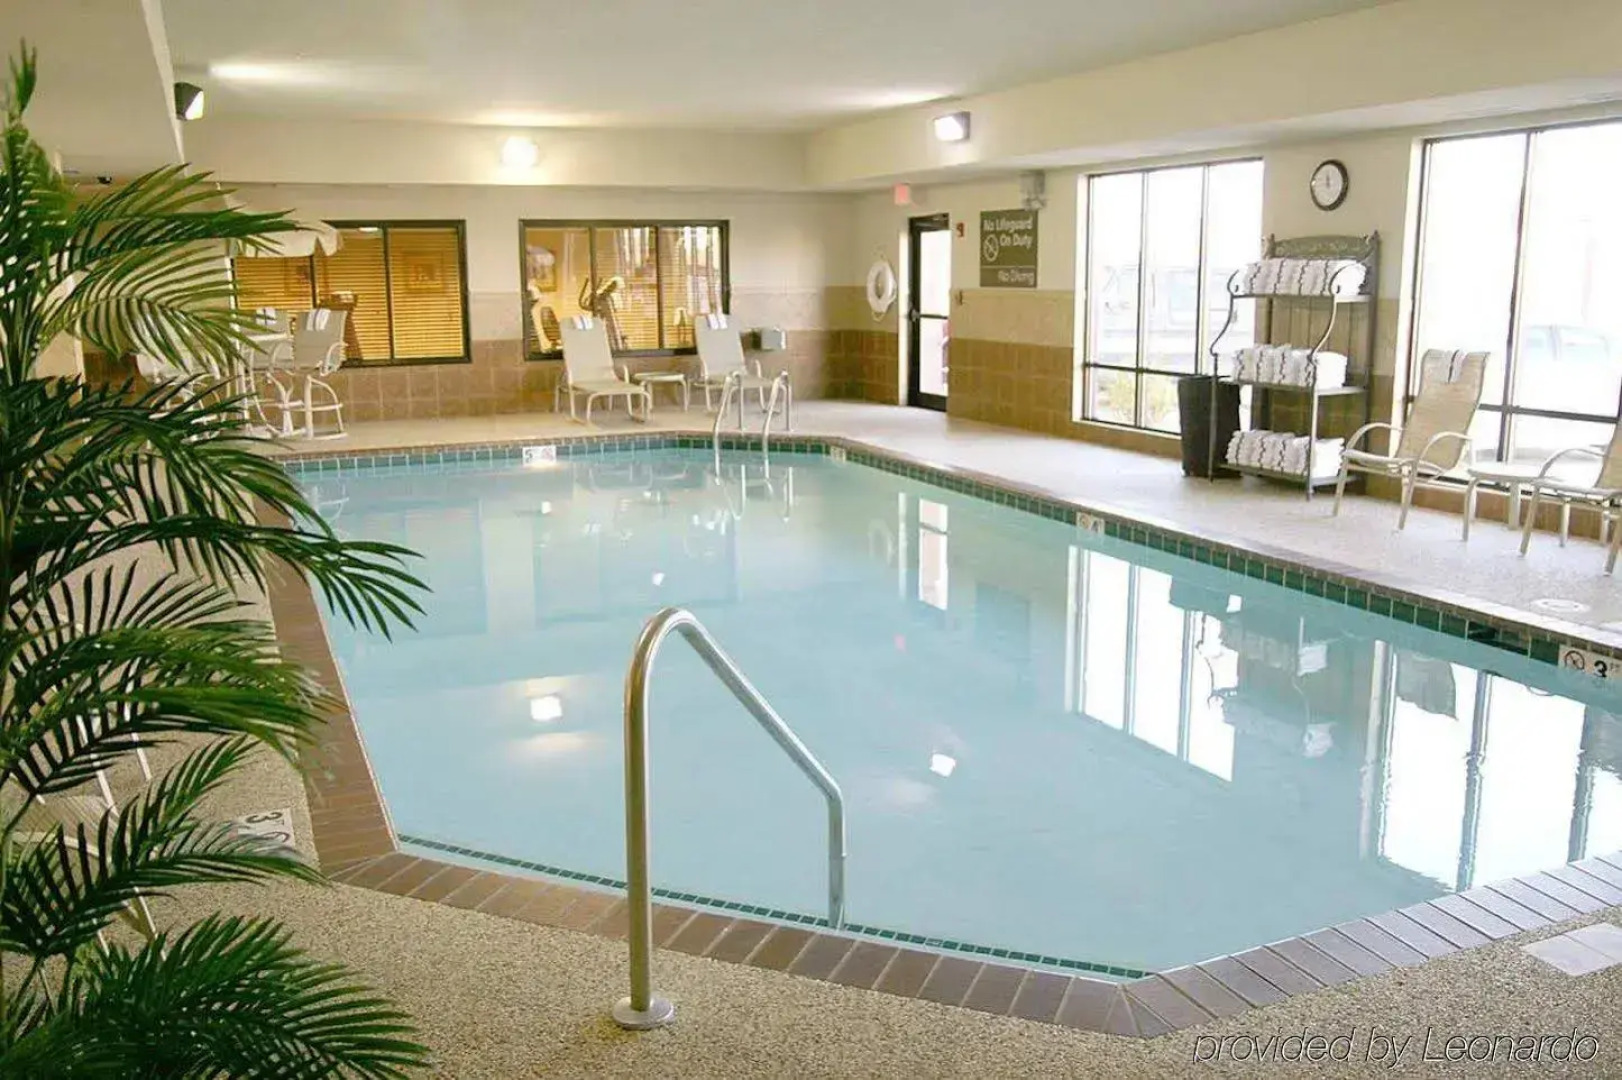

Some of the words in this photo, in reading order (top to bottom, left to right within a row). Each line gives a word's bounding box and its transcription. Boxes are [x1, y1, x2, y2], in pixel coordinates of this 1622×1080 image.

[983, 219, 994, 231] No
[996, 216, 1033, 233] Lifeguard
[1000, 233, 1011, 246] On
[1013, 232, 1033, 249] Duty
[1594, 660, 1607, 678] 3
[245, 811, 283, 824] 3
